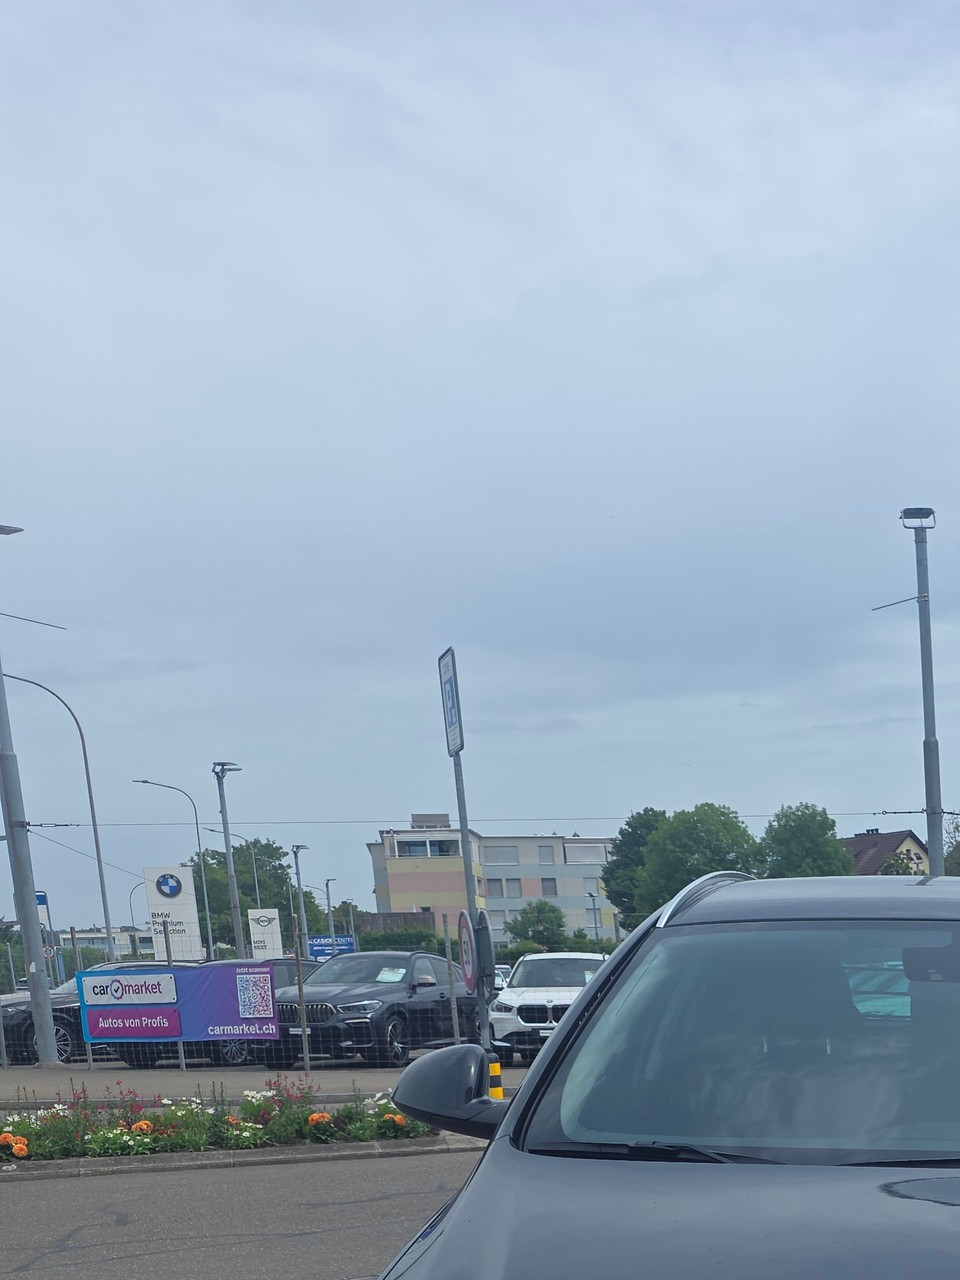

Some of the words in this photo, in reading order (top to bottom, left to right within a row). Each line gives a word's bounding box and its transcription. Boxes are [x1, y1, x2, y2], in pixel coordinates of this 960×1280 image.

[99, 1017, 123, 1028] Autos
[124, 1018, 141, 1027] von
[142, 1016, 169, 1027] Profis
[208, 1022, 276, 1035] carmarket.ch
